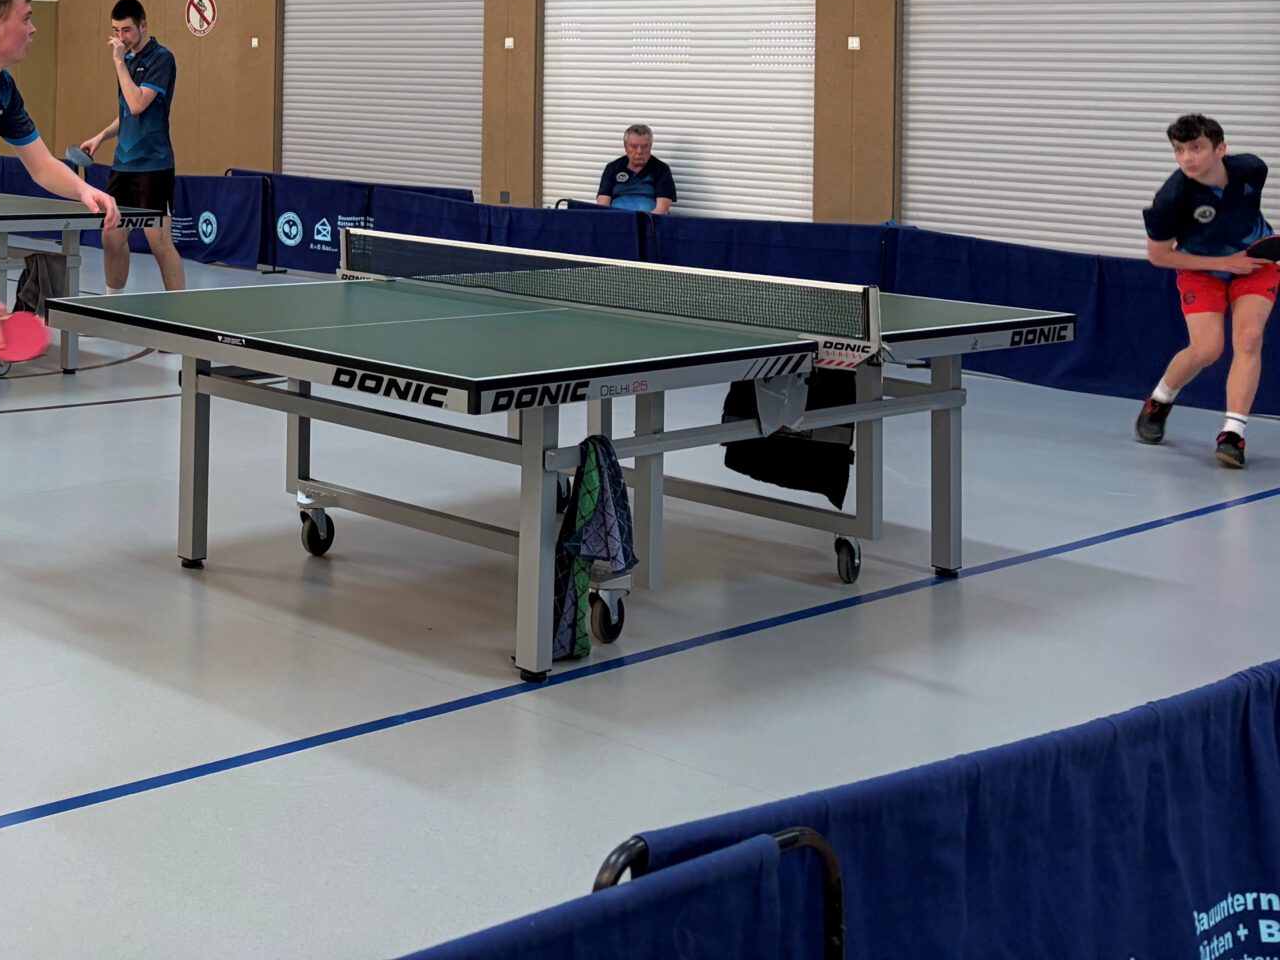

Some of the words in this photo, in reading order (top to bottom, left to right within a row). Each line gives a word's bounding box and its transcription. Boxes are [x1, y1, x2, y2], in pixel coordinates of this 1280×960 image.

[823, 341, 871, 353] DONIC
[1009, 325, 1069, 347] DONIC
[331, 367, 448, 409] DONIC
[491, 380, 591, 413] DONIC
[632, 380, 648, 395] 25
